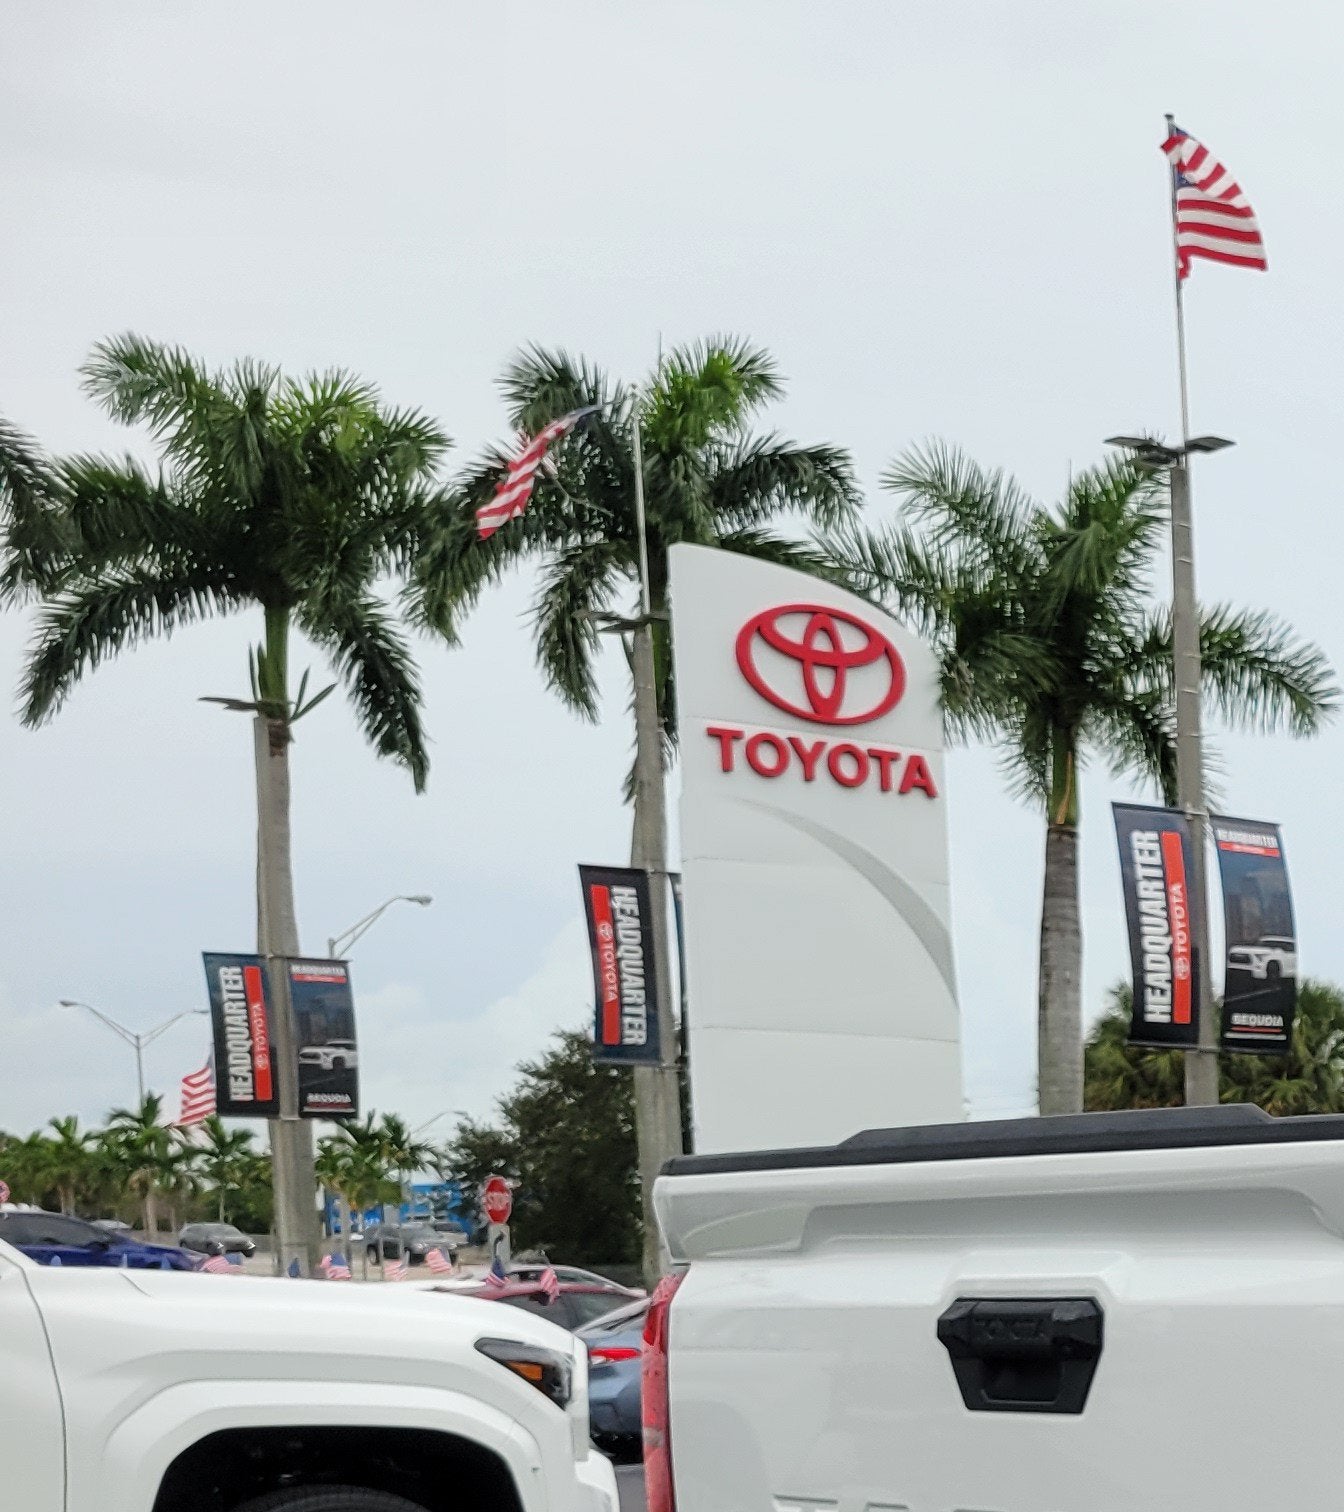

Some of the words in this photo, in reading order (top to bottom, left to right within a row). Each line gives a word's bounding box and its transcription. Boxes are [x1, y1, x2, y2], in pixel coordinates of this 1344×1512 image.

[706, 726, 938, 799] TOYOTA
[1130, 829, 1173, 1023] HEADQUARTER
[1170, 883, 1188, 955] TOYOTA
[600, 941, 618, 1003] TOYOTA
[611, 885, 647, 1045] HEADQUARTER
[219, 966, 254, 1101] HEADQUARTER
[252, 1003, 268, 1050] TOYOTA
